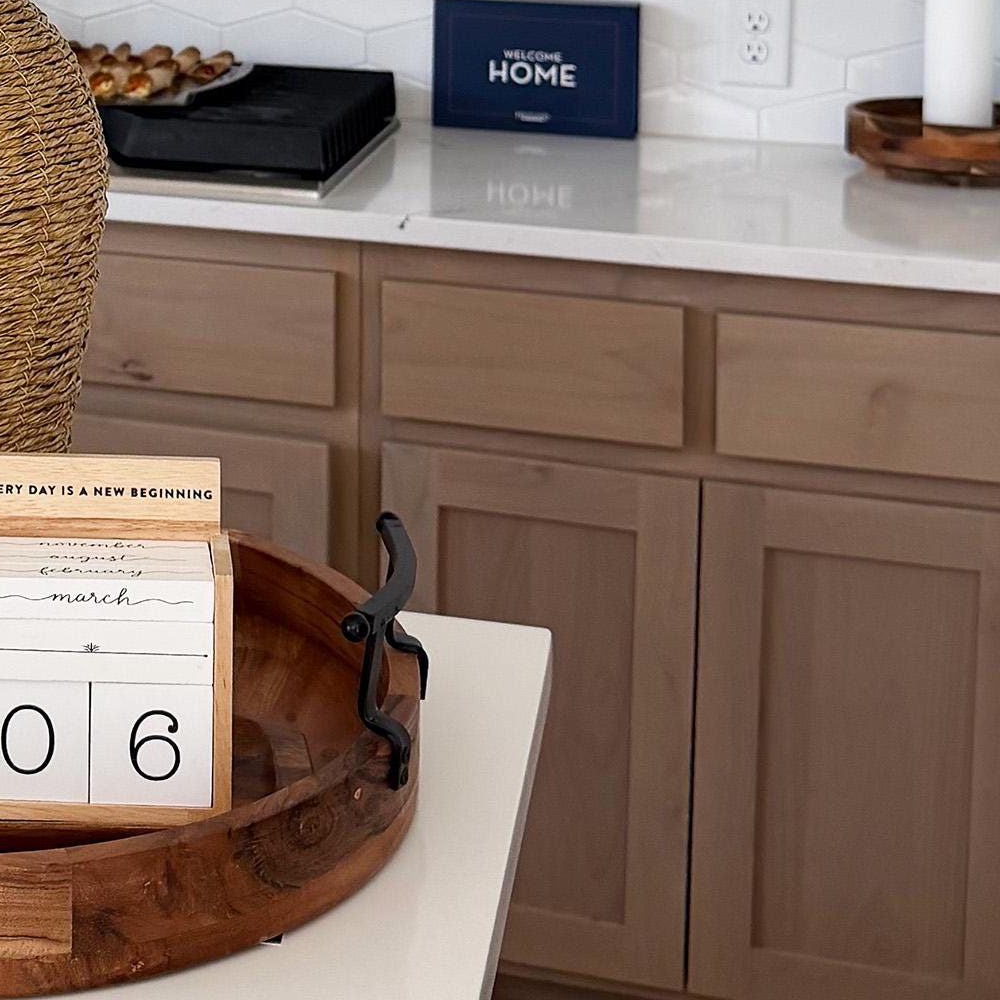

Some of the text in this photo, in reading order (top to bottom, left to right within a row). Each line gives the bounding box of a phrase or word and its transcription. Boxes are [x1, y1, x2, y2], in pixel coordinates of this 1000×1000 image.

[503, 49, 562, 63] WELCOME
[489, 60, 577, 88] HOME
[28, 484, 56, 496] DAY
[61, 485, 74, 496] IS
[78, 486, 88, 497] A
[93, 486, 125, 497] NEW
[130, 487, 213, 500] BEGINNING
[50, 554, 126, 562] august
[40, 566, 142, 577] february
[50, 587, 132, 605] march
[1, 704, 181, 782] 0 6
